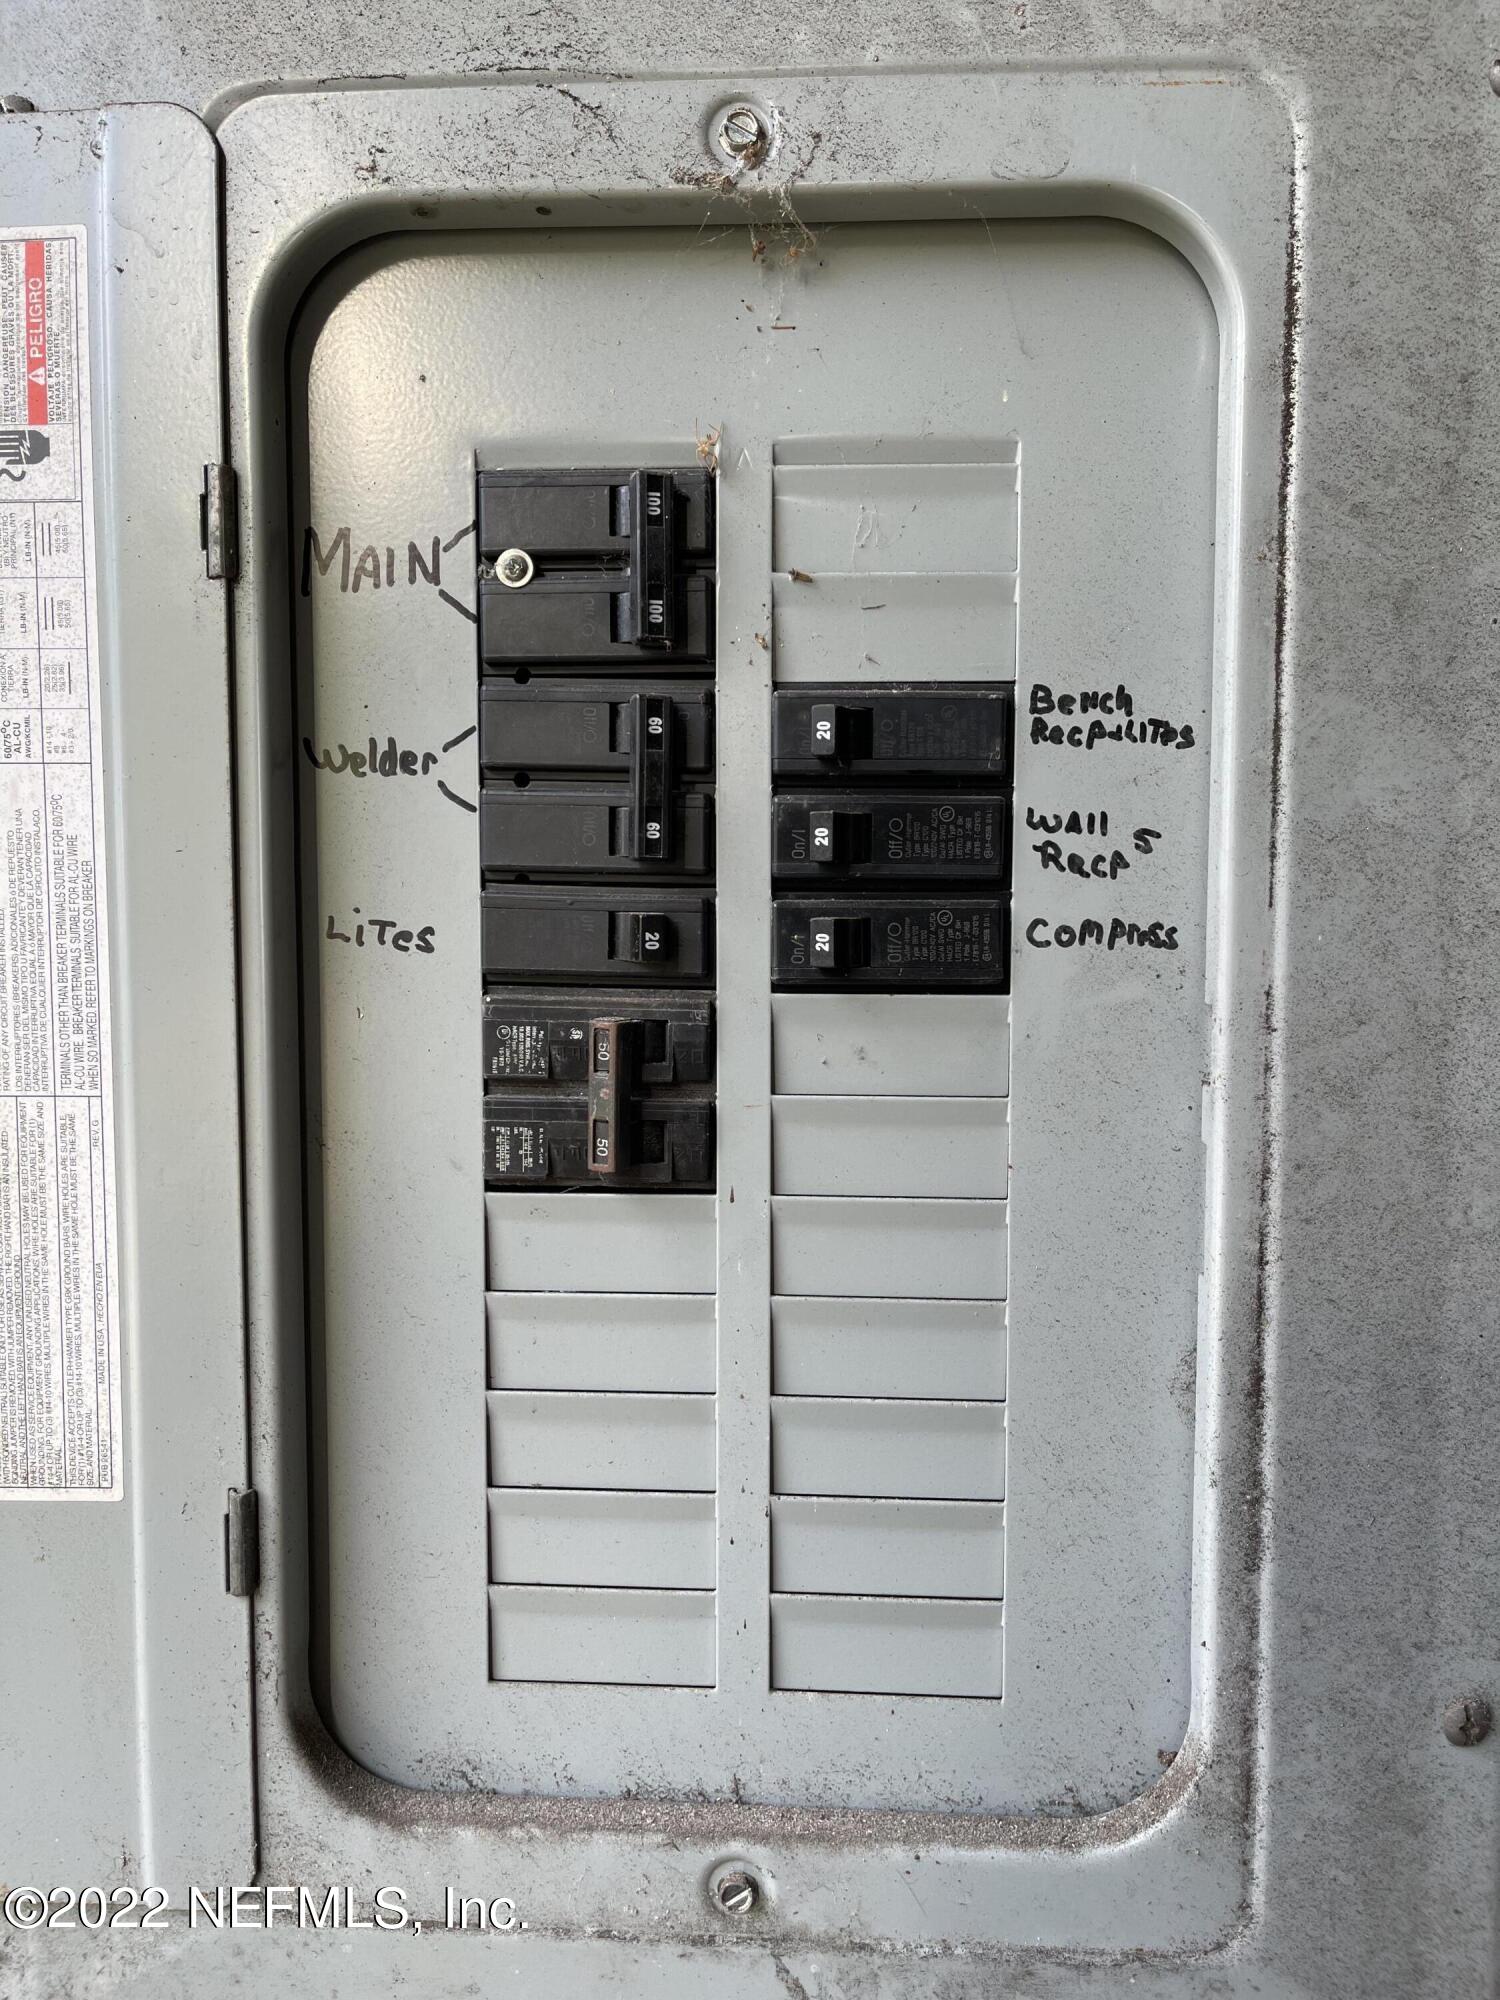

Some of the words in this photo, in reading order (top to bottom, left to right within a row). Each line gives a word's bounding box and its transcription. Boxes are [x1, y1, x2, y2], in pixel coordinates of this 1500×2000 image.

[29, 278, 43, 358] PELIGRO
[647, 492, 661, 516] 100
[301, 527, 441, 597] MAIN
[649, 599, 663, 624] 100
[13, 722, 21, 753] AL-CU
[24, 715, 32, 758] AWG/KCMIL
[648, 717, 662, 734] 60
[816, 721, 830, 740] 20
[303, 737, 438, 777] Welder
[53, 830, 63, 847] FOR
[646, 822, 661, 839] 60
[814, 827, 829, 846] 20
[67, 834, 77, 856] WIRE
[54, 850, 65, 889] SUITABLE
[68, 859, 78, 884] AL-CU
[82, 860, 93, 900] BREAKER
[69, 887, 79, 904] FOR
[55, 892, 66, 940] TERMINALS
[83, 904, 93, 916] ON
[70, 906, 80, 943] SUITABLE
[84, 919, 95, 964] MARKINGS
[645, 932, 660, 950] 20
[815, 933, 830, 952] 20
[57, 943, 67, 983] BREAKER
[71, 948, 82, 992] TERMINALS
[85, 966, 95, 978] TO
[58, 986, 68, 1008] THAN
[86, 980, 96, 1008] REFER
[59, 1011, 69, 1040] OTHER
[72, 994, 83, 1034] BREAKER
[87, 1050, 98, 1062] SO
[597, 1042, 609, 1061] 50
[60, 1043, 71, 1089] TERMINALS
[74, 1066, 85, 1090] AL-CU
[88, 1065, 98, 1090] WHEN
[596, 1138, 609, 1157] 50
[96, 1281, 103, 1292] EN
